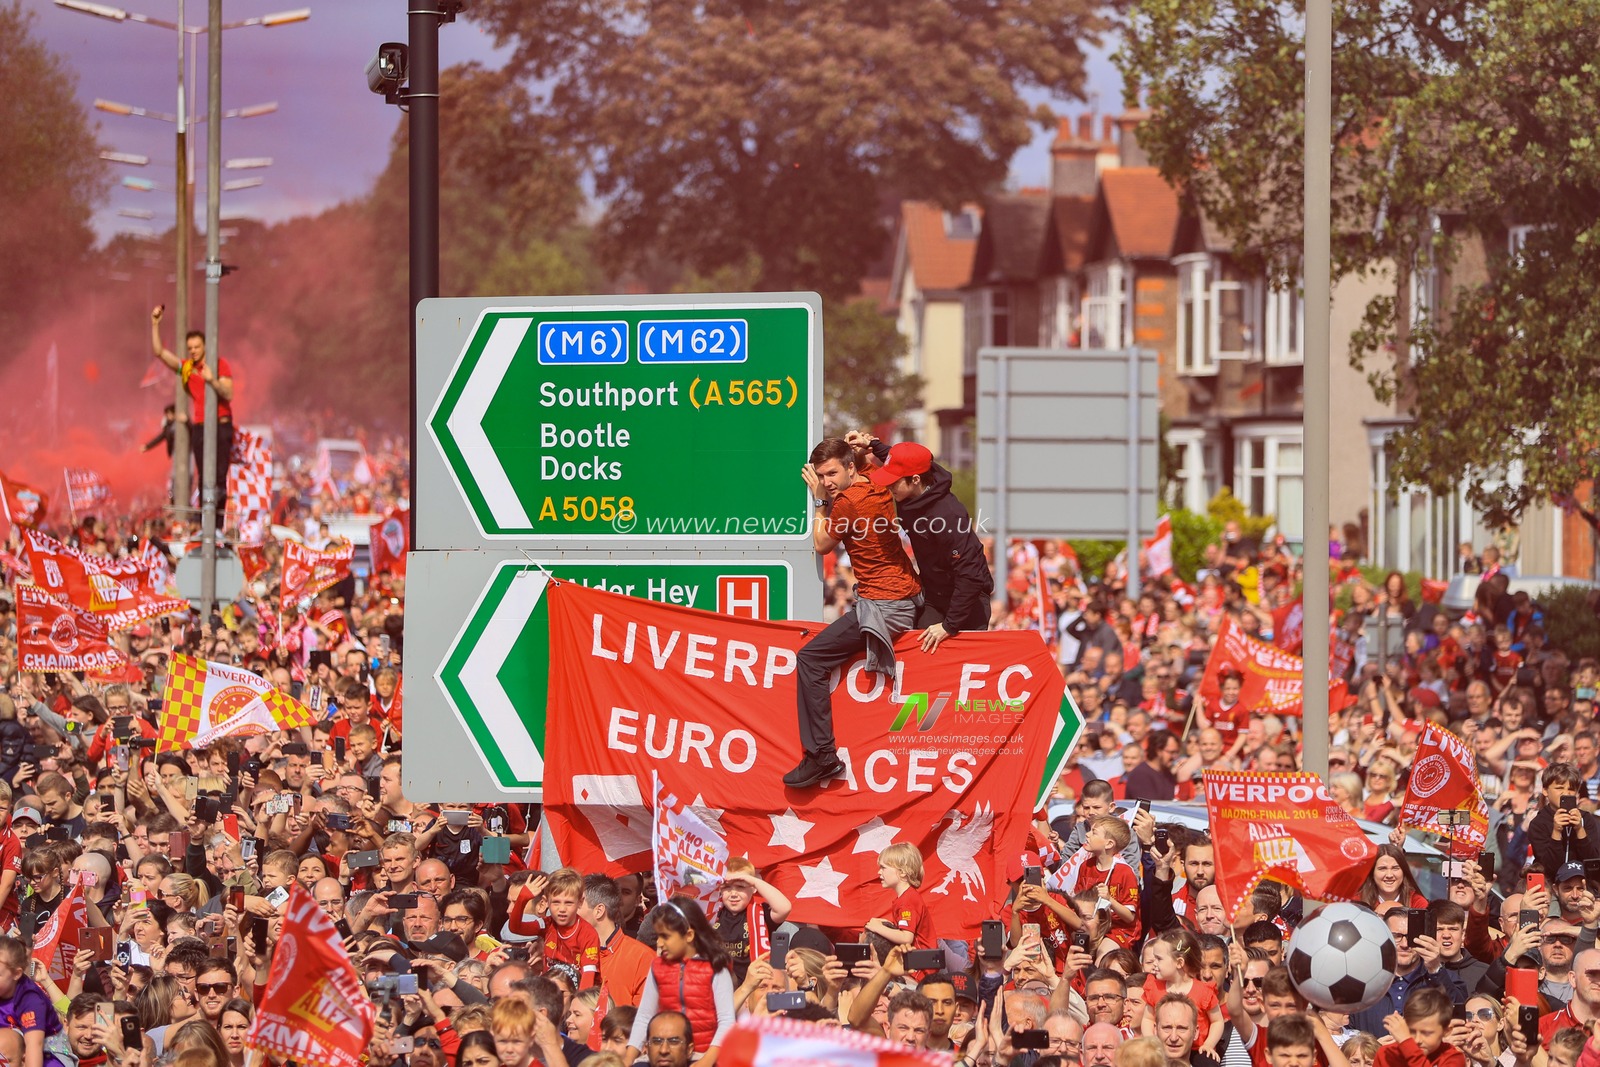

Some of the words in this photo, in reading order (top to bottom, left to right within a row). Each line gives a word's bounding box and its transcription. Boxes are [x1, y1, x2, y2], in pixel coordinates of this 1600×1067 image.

[539, 381, 678, 411] Southport
[541, 422, 631, 448] Bootle
[541, 455, 622, 481] Docks
[567, 578, 635, 598] der
[648, 577, 699, 608] Hey
[23, 650, 121, 668] CHAMPIONS
[591, 613, 919, 704] LIVERPOL
[958, 663, 1032, 707] FC
[607, 706, 757, 774] EURO
[1292, 808, 1319, 820] 2019
[685, 831, 703, 848] MO
[1248, 822, 1291, 842] ALLEZ
[1253, 837, 1297, 864] ALLEZ
